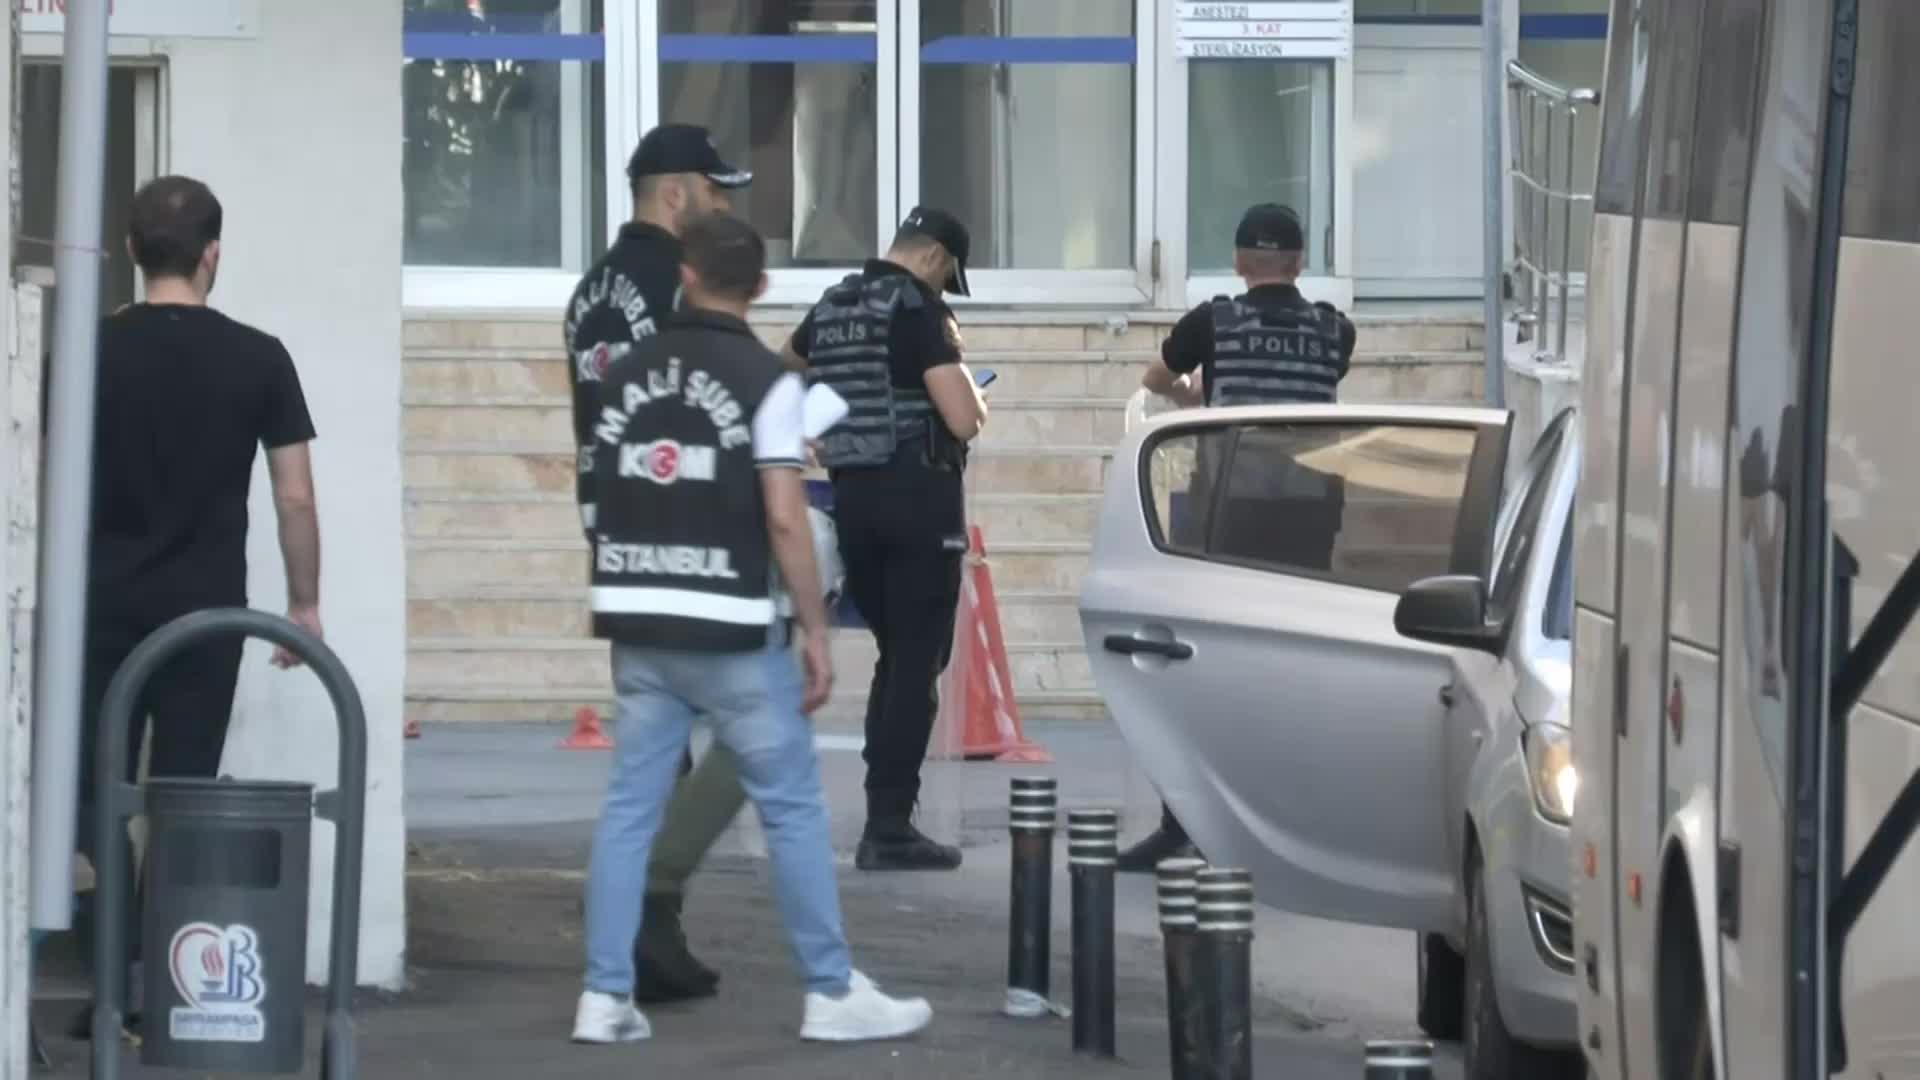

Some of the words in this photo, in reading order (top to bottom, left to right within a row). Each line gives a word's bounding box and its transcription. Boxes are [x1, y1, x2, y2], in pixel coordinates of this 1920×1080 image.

[816, 321, 867, 345] POLİS
[1248, 336, 1321, 357] POLİS
[595, 356, 682, 445] MALİ
[684, 369, 751, 449] ŞUBE
[597, 534, 739, 579] İSTANBUL
